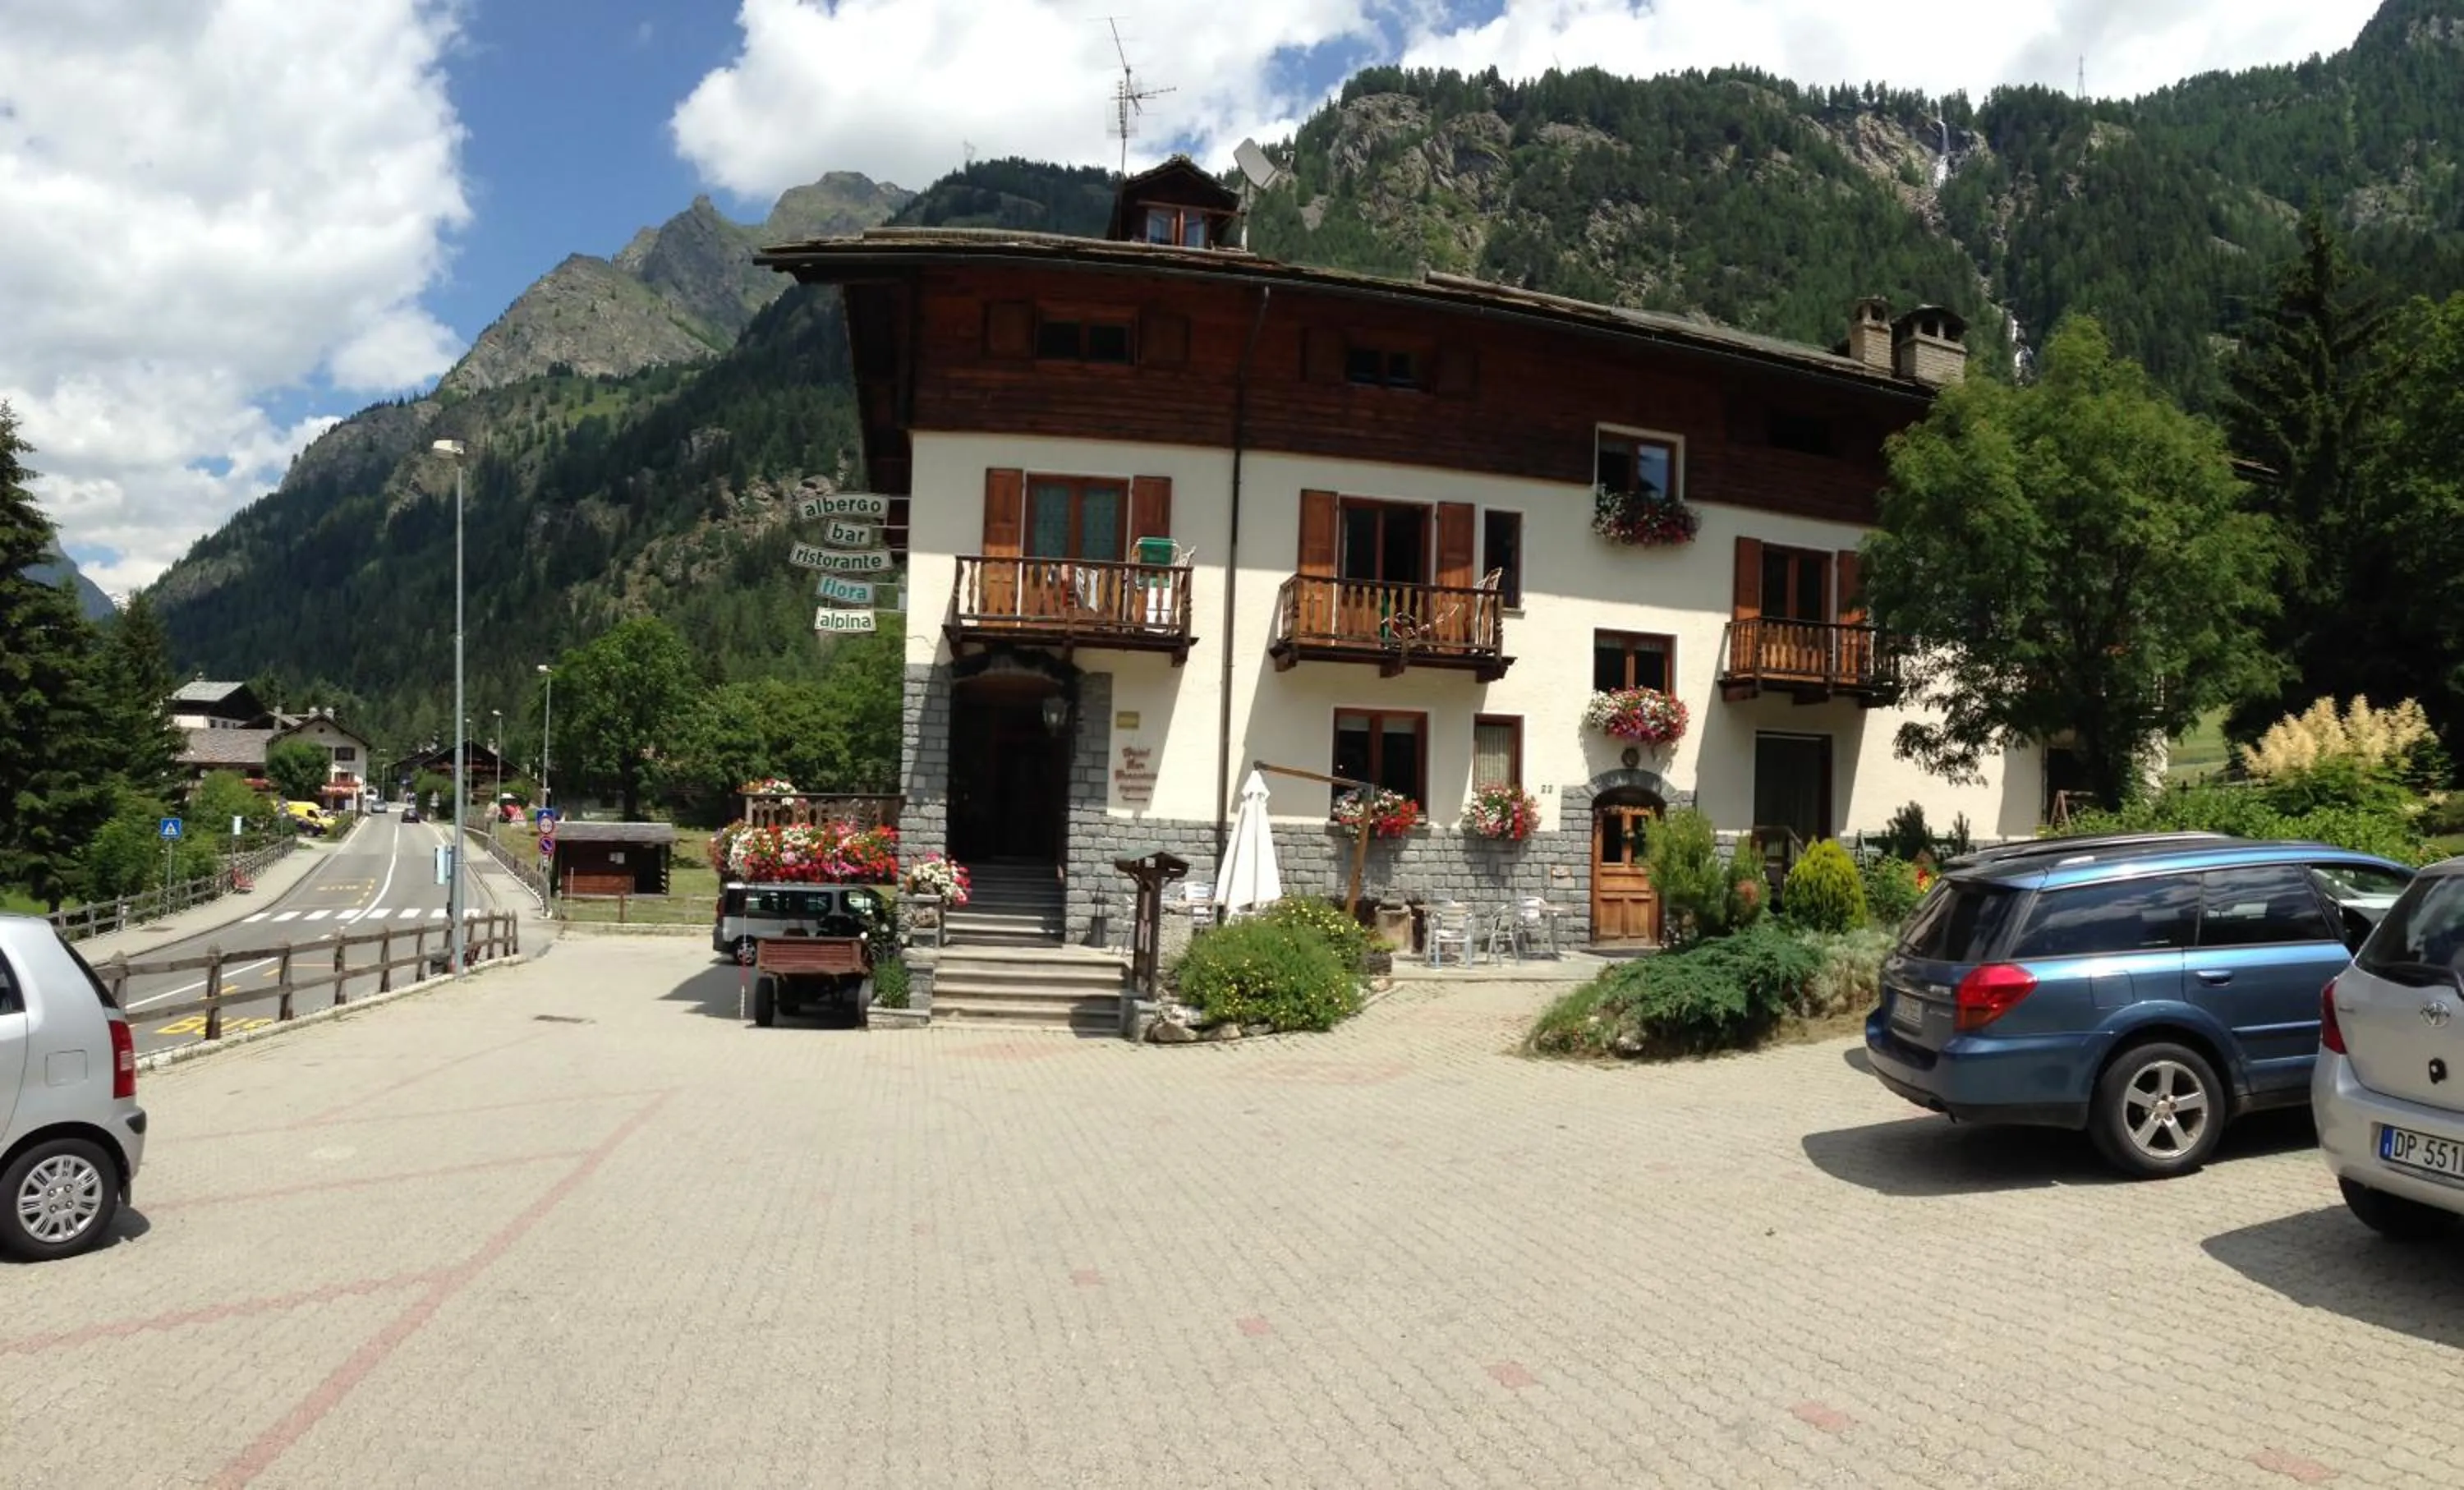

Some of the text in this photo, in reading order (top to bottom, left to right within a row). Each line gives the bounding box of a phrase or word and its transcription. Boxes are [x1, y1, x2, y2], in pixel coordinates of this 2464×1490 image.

[832, 523, 866, 543] bar
[795, 548, 881, 569] ristorante
[823, 577, 868, 600] flora
[820, 613, 871, 629] alpina
[2393, 1130, 2417, 1159] DP
